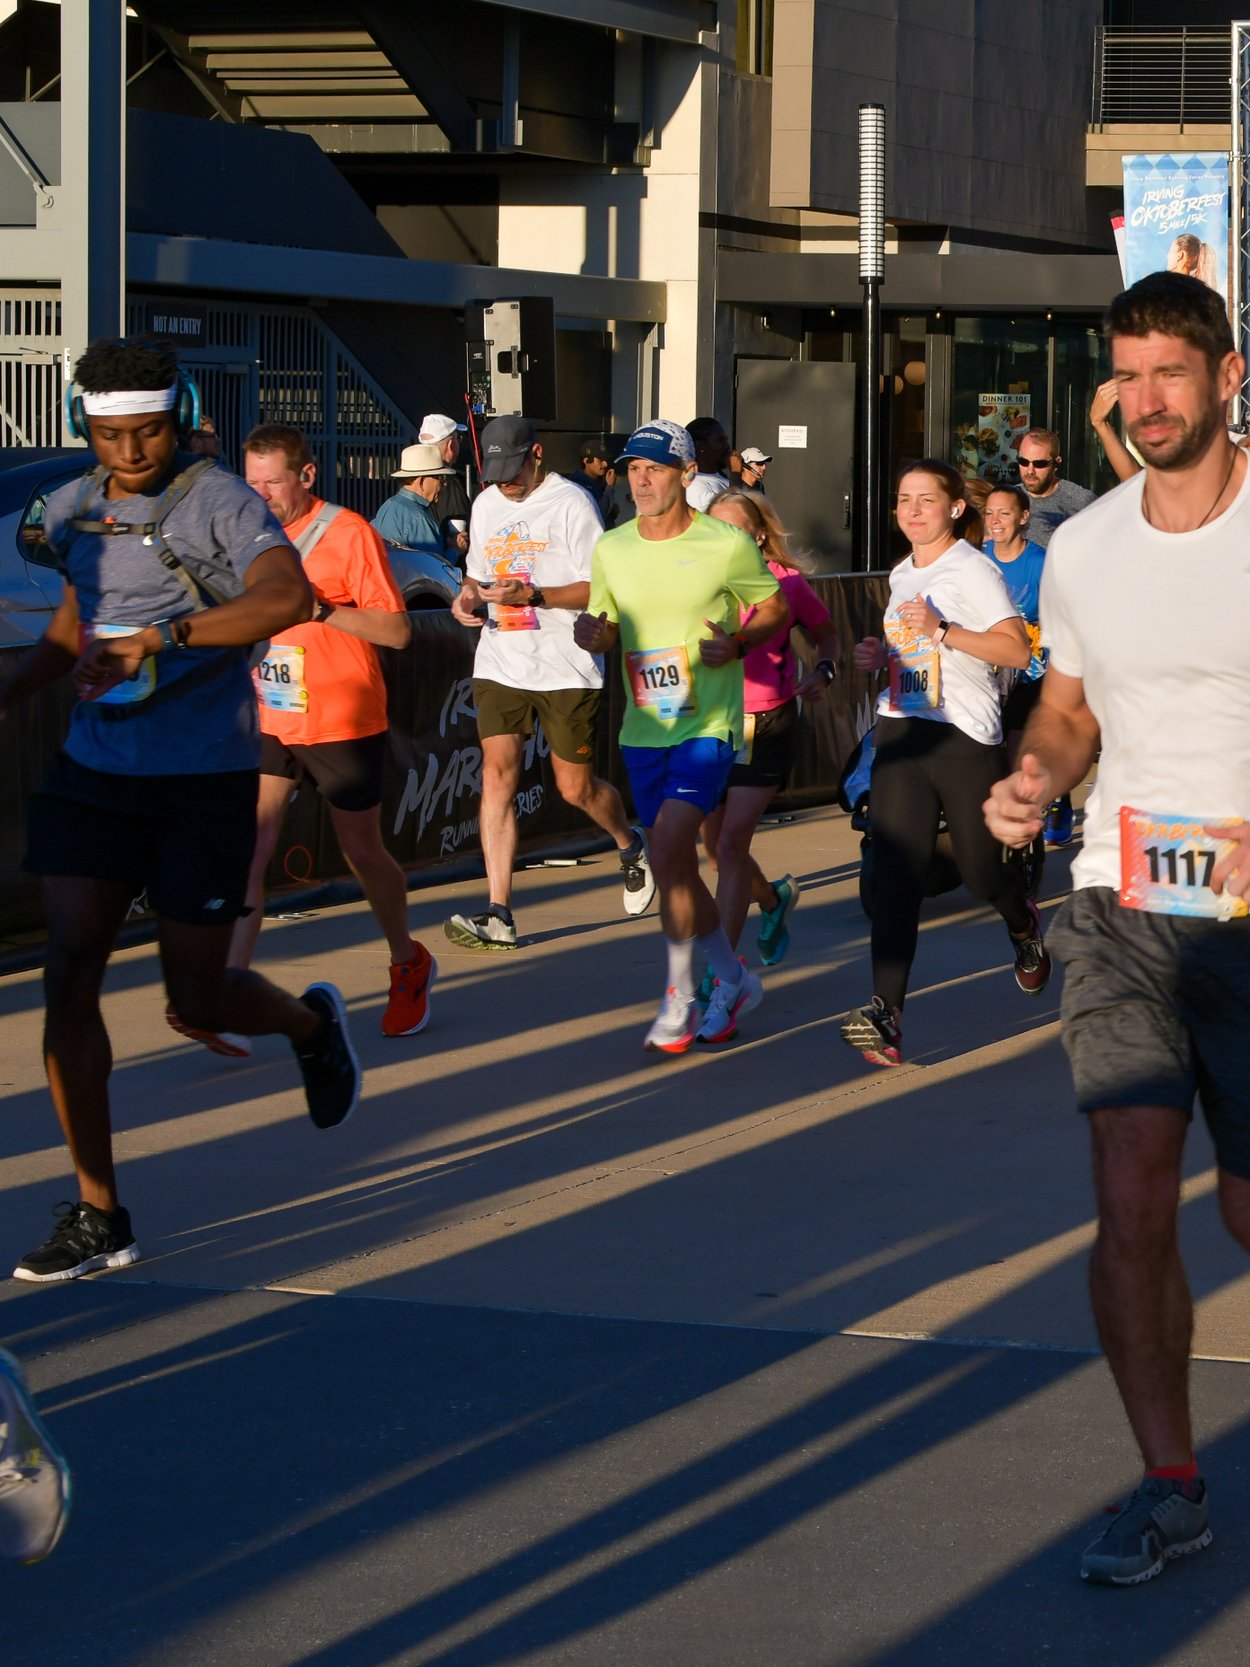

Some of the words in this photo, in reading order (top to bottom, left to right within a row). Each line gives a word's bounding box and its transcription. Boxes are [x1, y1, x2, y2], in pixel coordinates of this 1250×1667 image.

[1142, 184, 1185, 205] IRVING
[1130, 192, 1227, 228] OKTOBERFEST
[1157, 221, 1169, 235] 5
[153, 315, 168, 333] NOT
[168, 316, 179, 334] AN
[180, 317, 202, 335] ENTRY
[982, 395, 1012, 403] DINNER
[1015, 395, 1027, 403] 101
[638, 665, 680, 690] 1129
[899, 669, 929, 694] 1008
[1144, 846, 1216, 888] 1117
